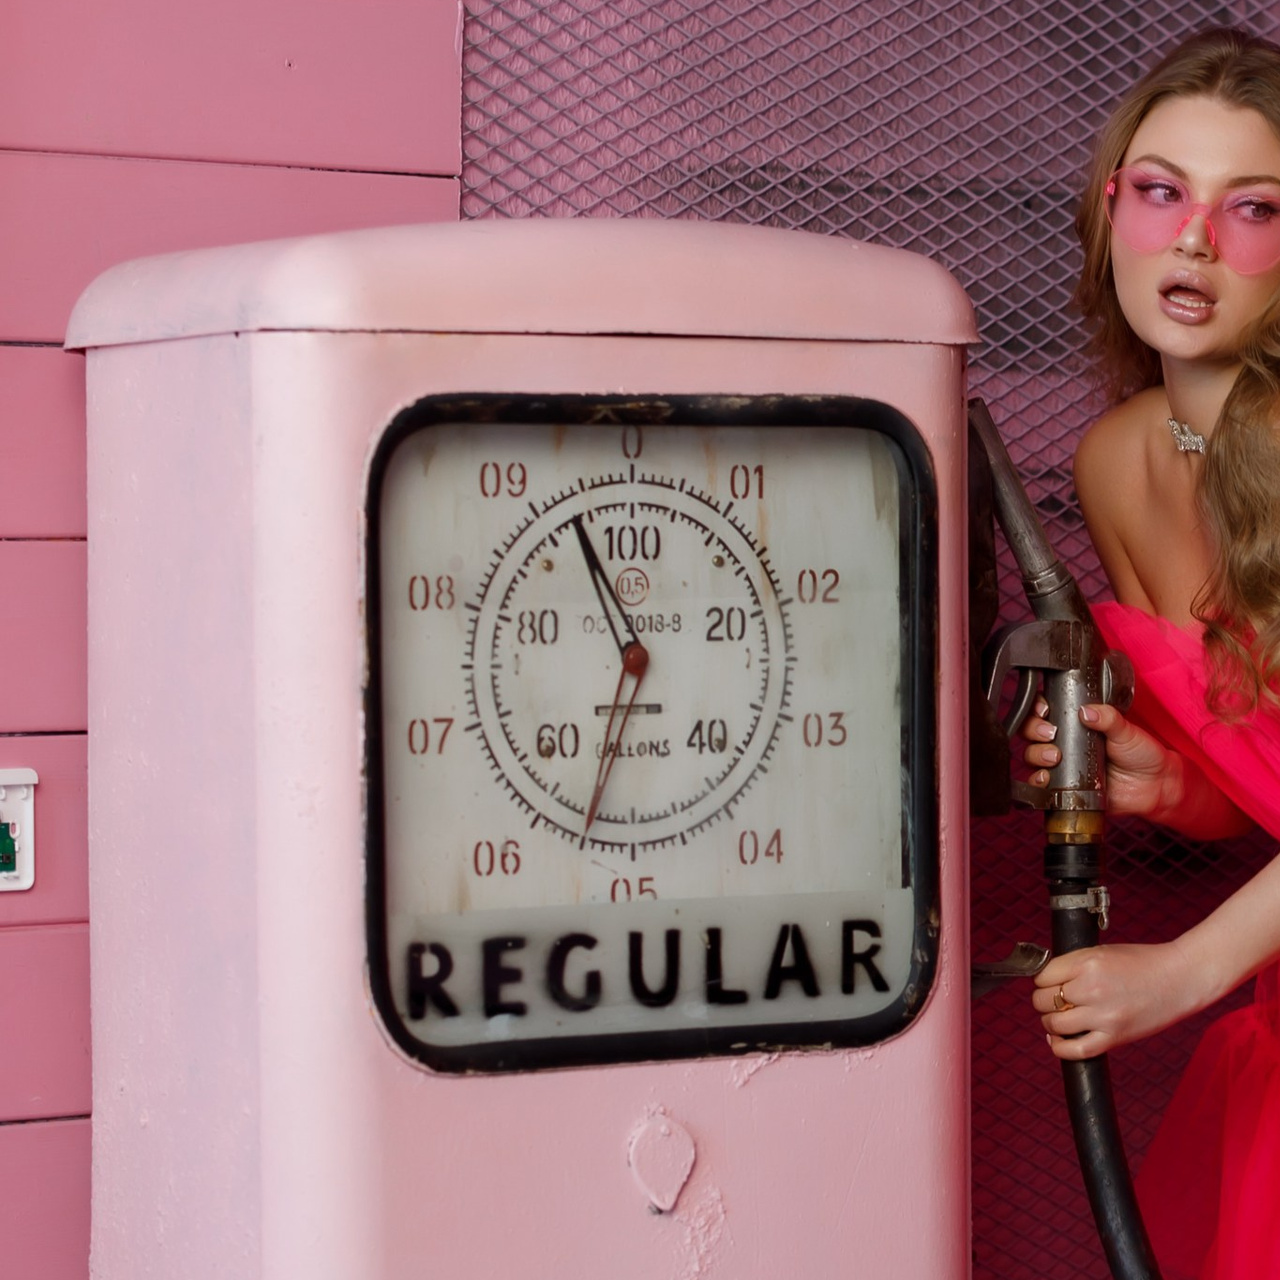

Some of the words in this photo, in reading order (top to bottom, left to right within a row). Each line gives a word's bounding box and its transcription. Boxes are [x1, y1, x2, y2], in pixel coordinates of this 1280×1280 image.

[479, 461, 528, 499] 09
[729, 463, 765, 500] 01
[604, 525, 661, 561] 100
[408, 574, 456, 612] 08
[796, 568, 841, 604] 02
[516, 607, 560, 645] 80
[705, 606, 747, 642] 20
[407, 716, 454, 756] 07
[535, 722, 580, 759] 60
[686, 718, 728, 755] 40
[802, 710, 849, 748] 03
[473, 840, 521, 877] 06
[737, 828, 785, 865] 04
[609, 876, 658, 904] 05
[404, 918, 890, 1021] REGULAR
